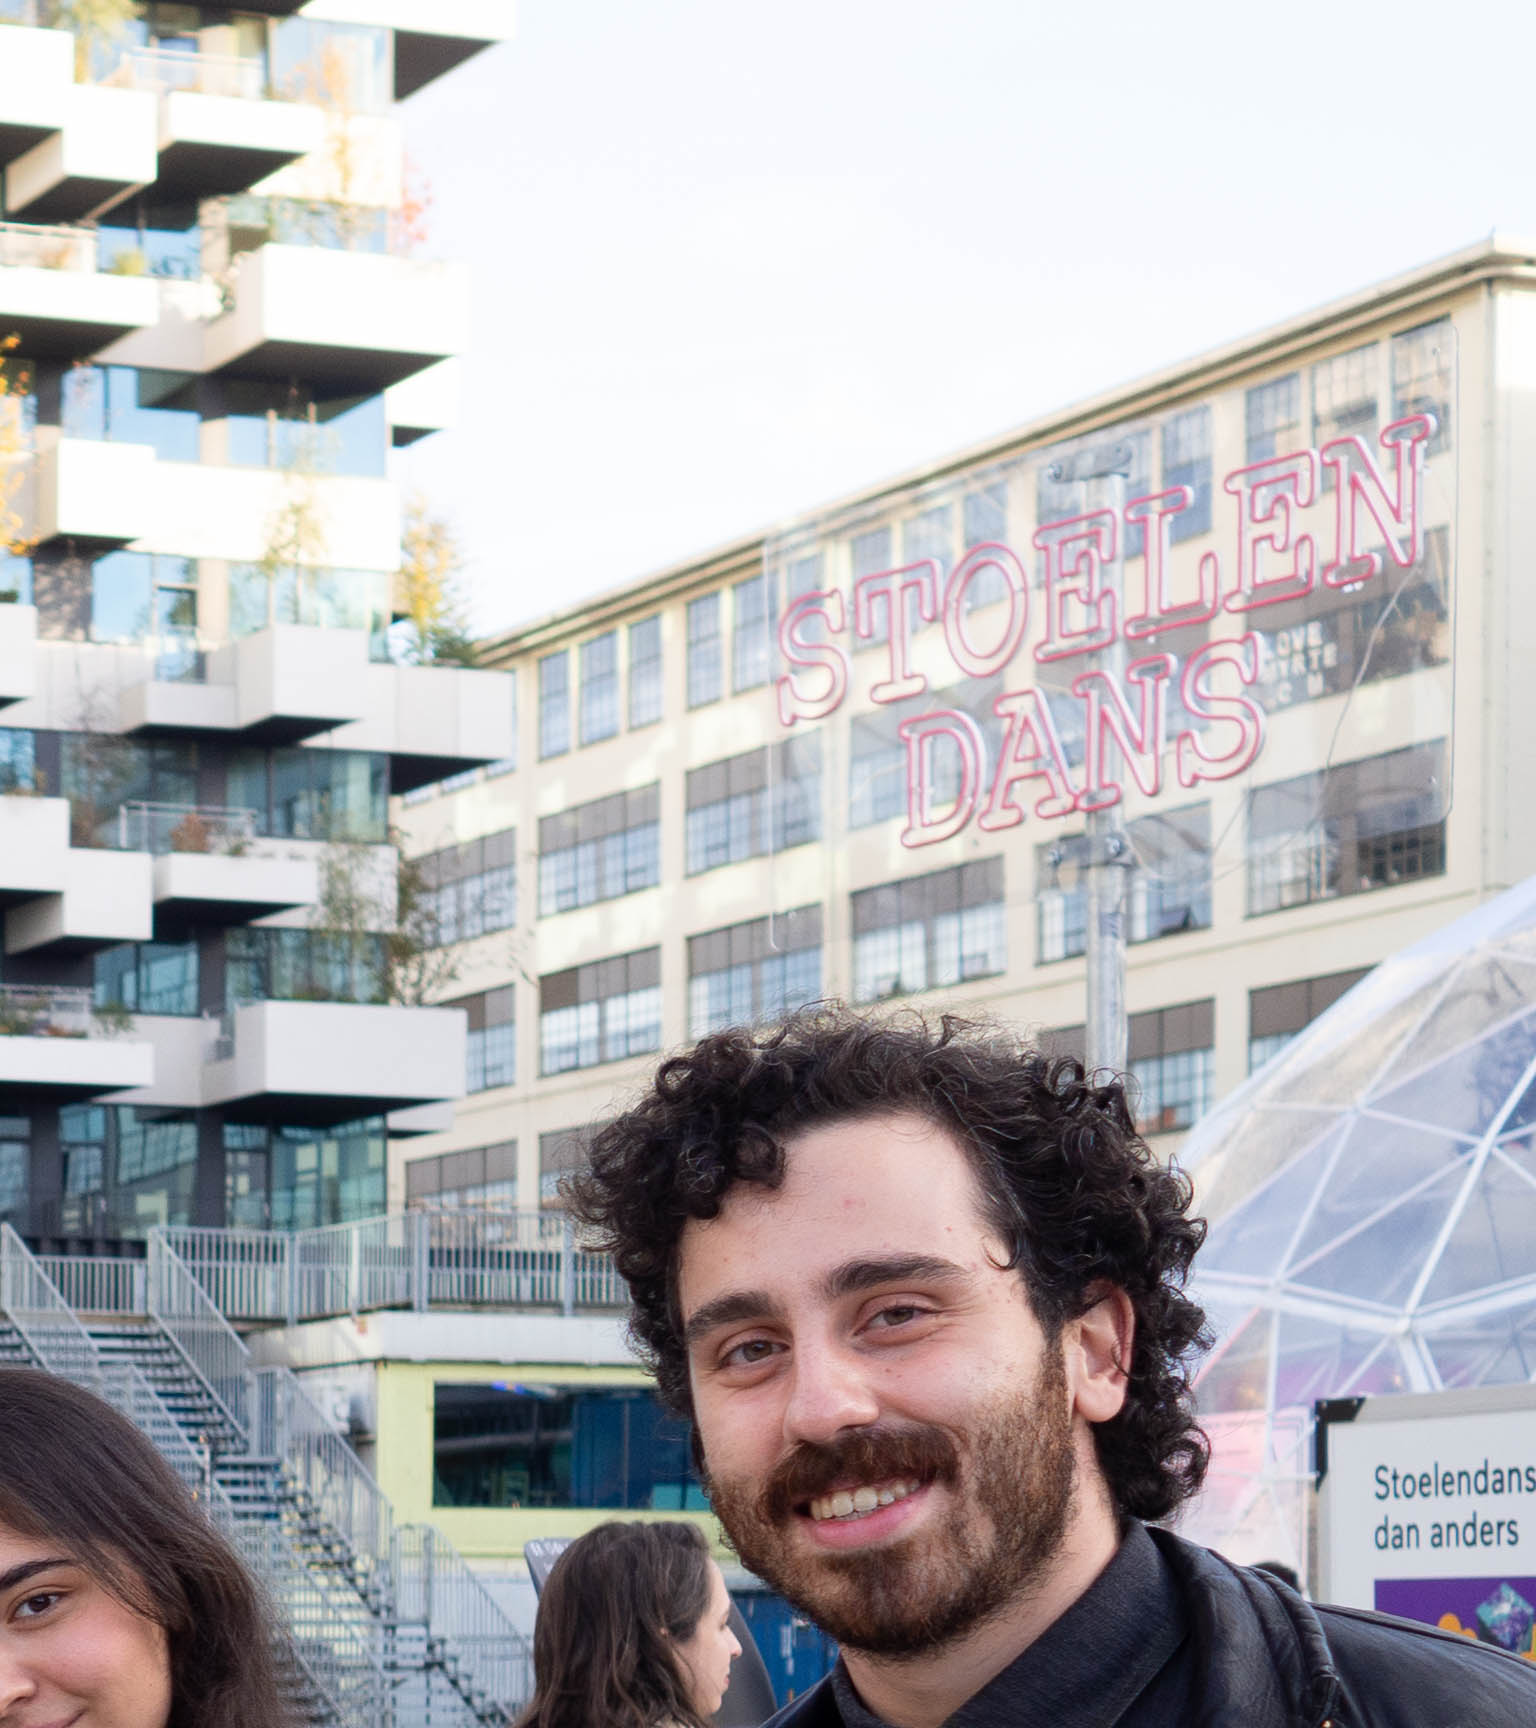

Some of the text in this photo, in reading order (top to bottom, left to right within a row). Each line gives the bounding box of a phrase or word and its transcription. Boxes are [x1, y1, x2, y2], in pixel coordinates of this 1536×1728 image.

[778, 413, 1437, 727] STOELEN
[900, 631, 1265, 849] DANS
[1374, 1458, 1536, 1500] Stoelendans
[1374, 1511, 1519, 1550] dan anders
